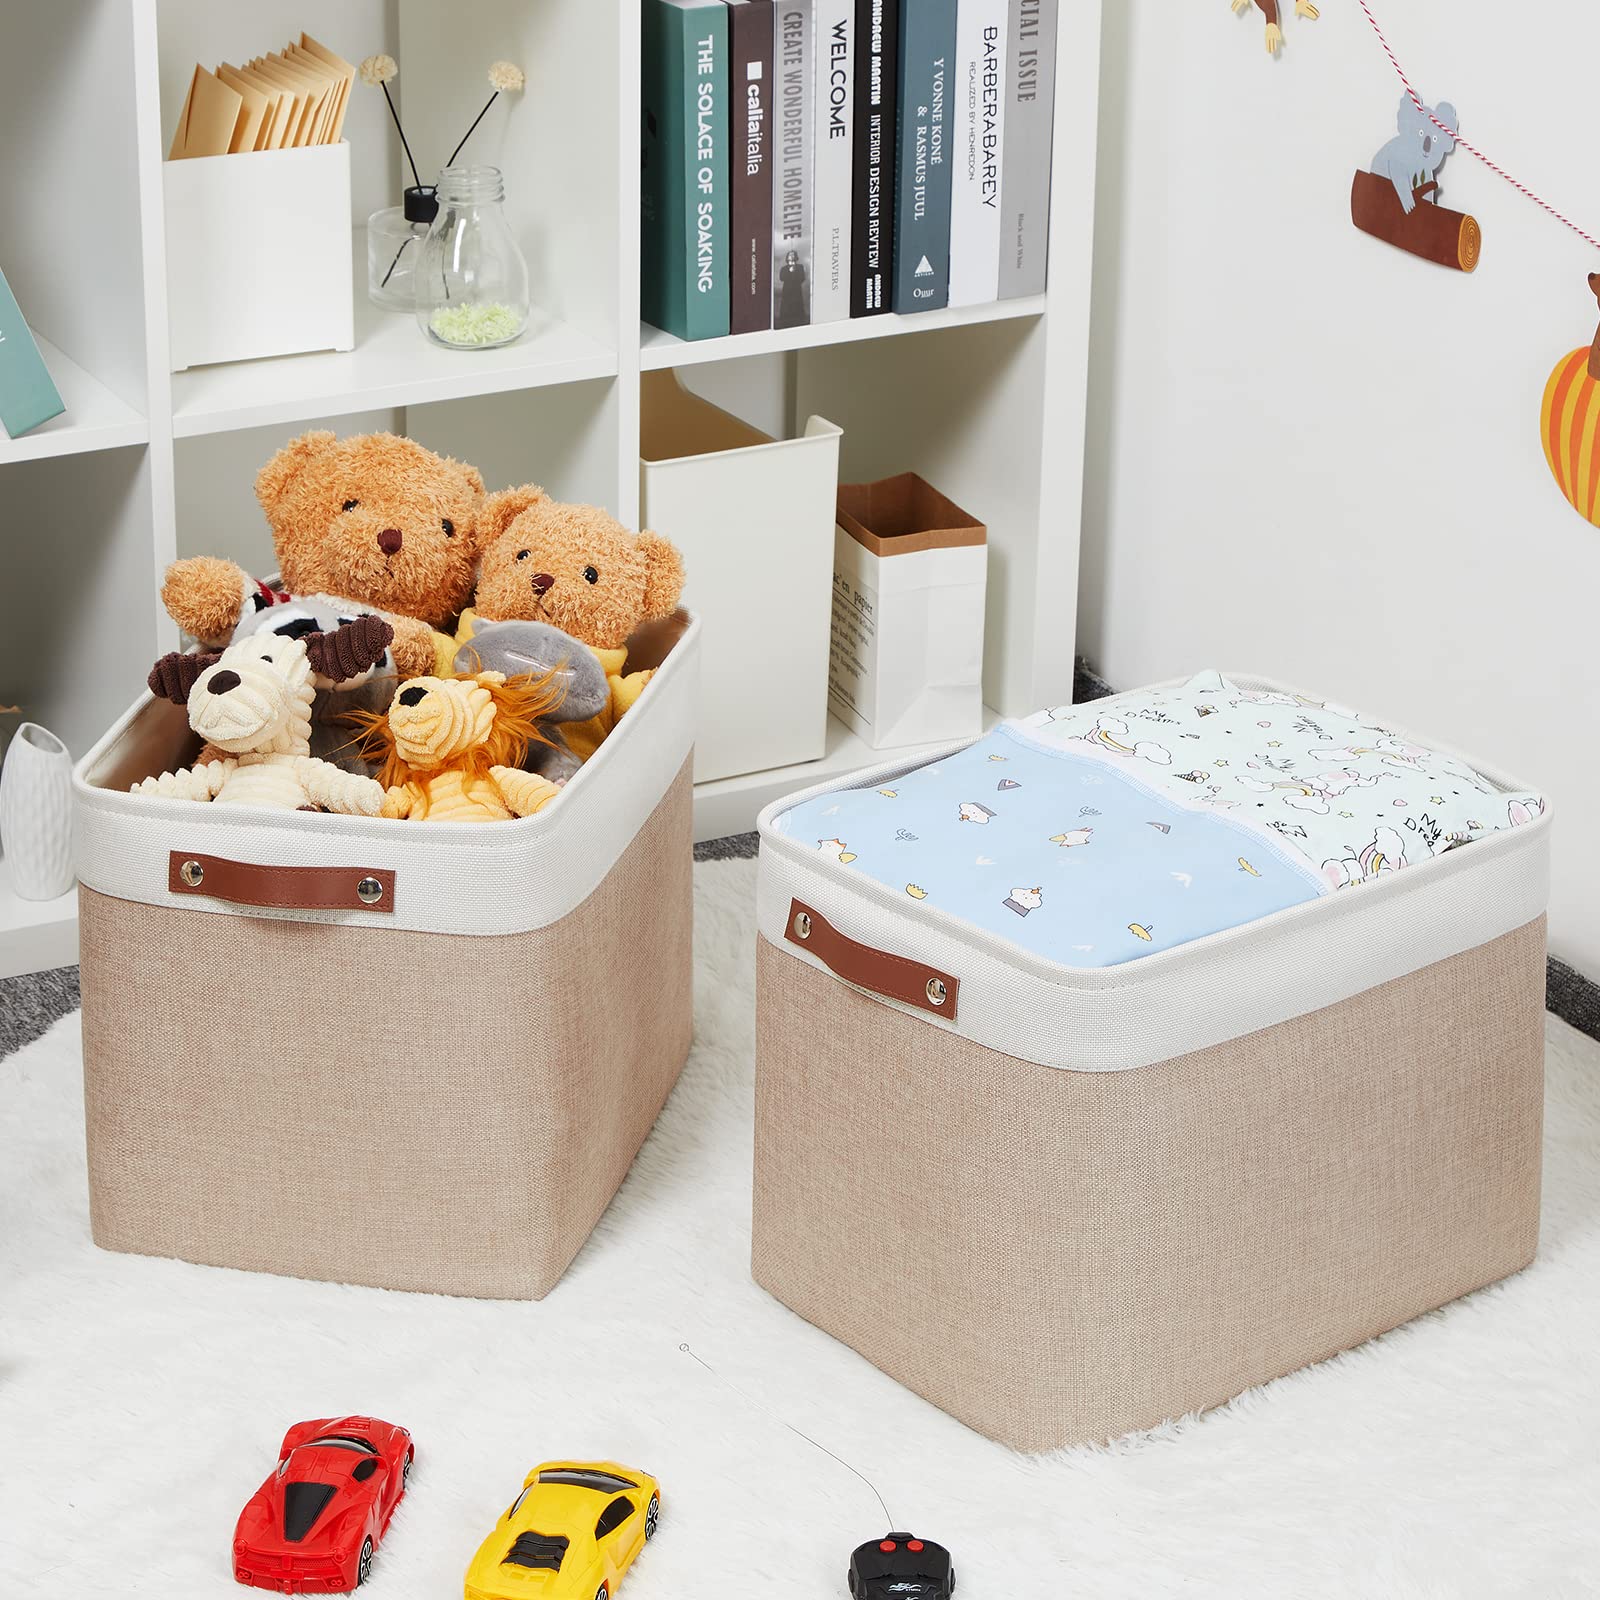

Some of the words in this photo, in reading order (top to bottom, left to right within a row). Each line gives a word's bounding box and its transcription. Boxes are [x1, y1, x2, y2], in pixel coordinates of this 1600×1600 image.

[784, 11, 803, 65] CREATE
[871, 0, 882, 53] ANDREW
[698, 35, 713, 75] THE
[830, 19, 847, 139] WELCOME
[870, 56, 881, 105] MARTIN
[1018, 50, 1038, 102] ISSUE
[698, 83, 713, 160] SOLACE
[747, 84, 763, 175] caliaitalia
[784, 74, 803, 163] WONDERFUL
[869, 114, 881, 165] INTERIOR
[968, 112, 975, 124] BY
[982, 26, 997, 208] BARBERABAREY
[915, 126, 927, 182] RASMUS
[930, 125, 943, 164] KONÉ
[698, 167, 713, 194] OF
[784, 168, 803, 240] HOMELIFE
[868, 167, 880, 216] DESIGN
[914, 186, 925, 220] JUUL
[698, 203, 713, 293] SOAKING
[1420, 813, 1442, 841] My
